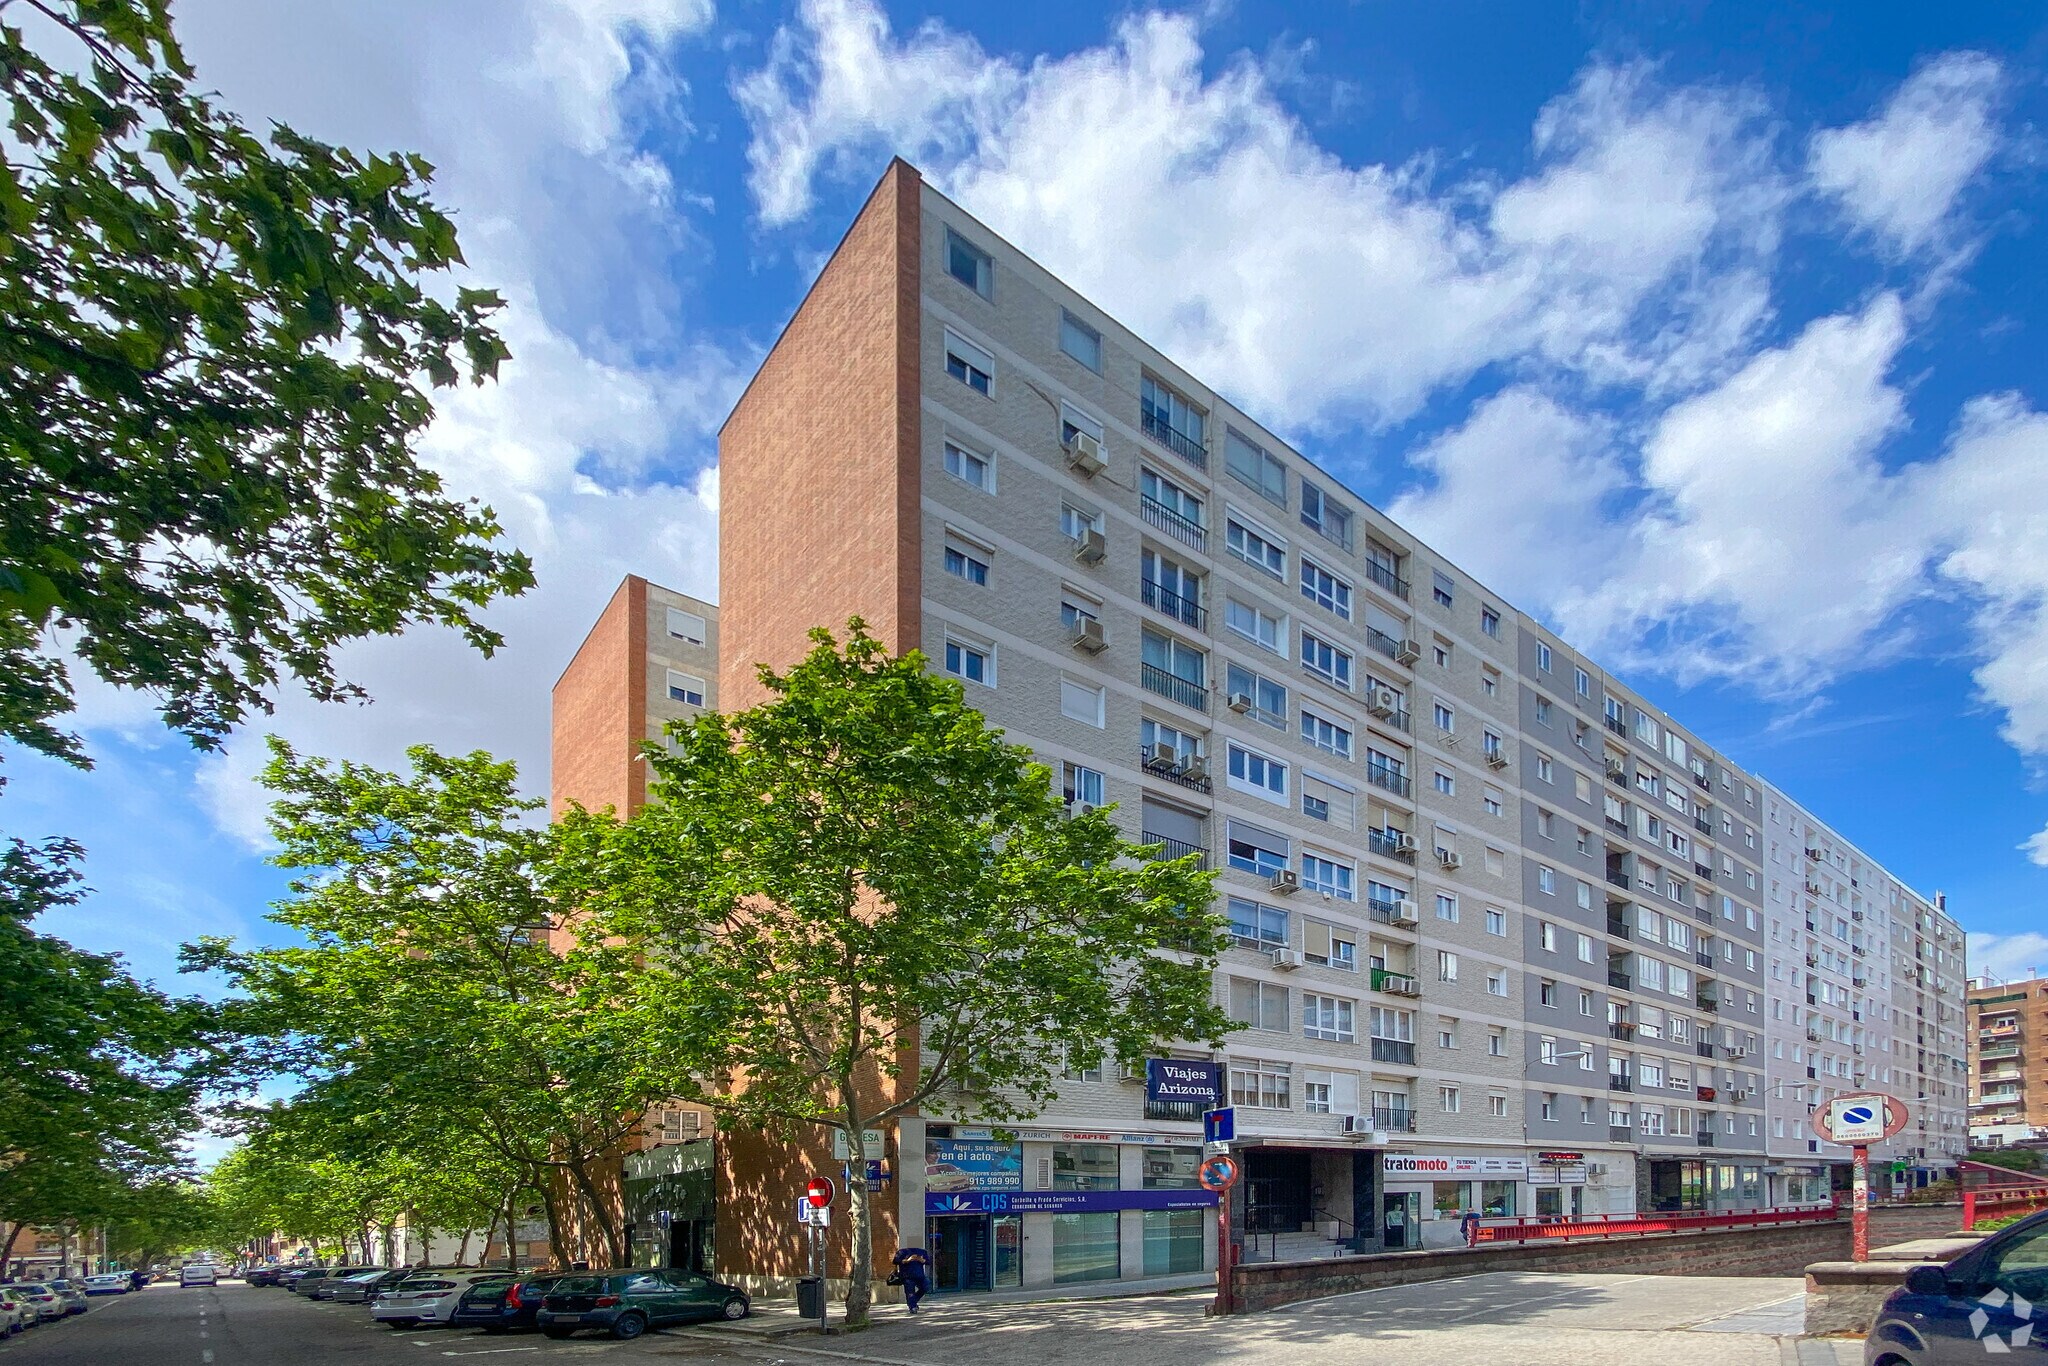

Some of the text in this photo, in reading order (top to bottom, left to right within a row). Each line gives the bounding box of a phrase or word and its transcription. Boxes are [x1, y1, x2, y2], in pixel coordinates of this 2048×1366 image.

[1163, 1066, 1207, 1081] Viajes
[1158, 1083, 1215, 1096] Arizona
[985, 1145, 1011, 1153] seguro
[941, 1151, 995, 1161] en el acto.
[969, 1177, 1020, 1185] 915 989 990
